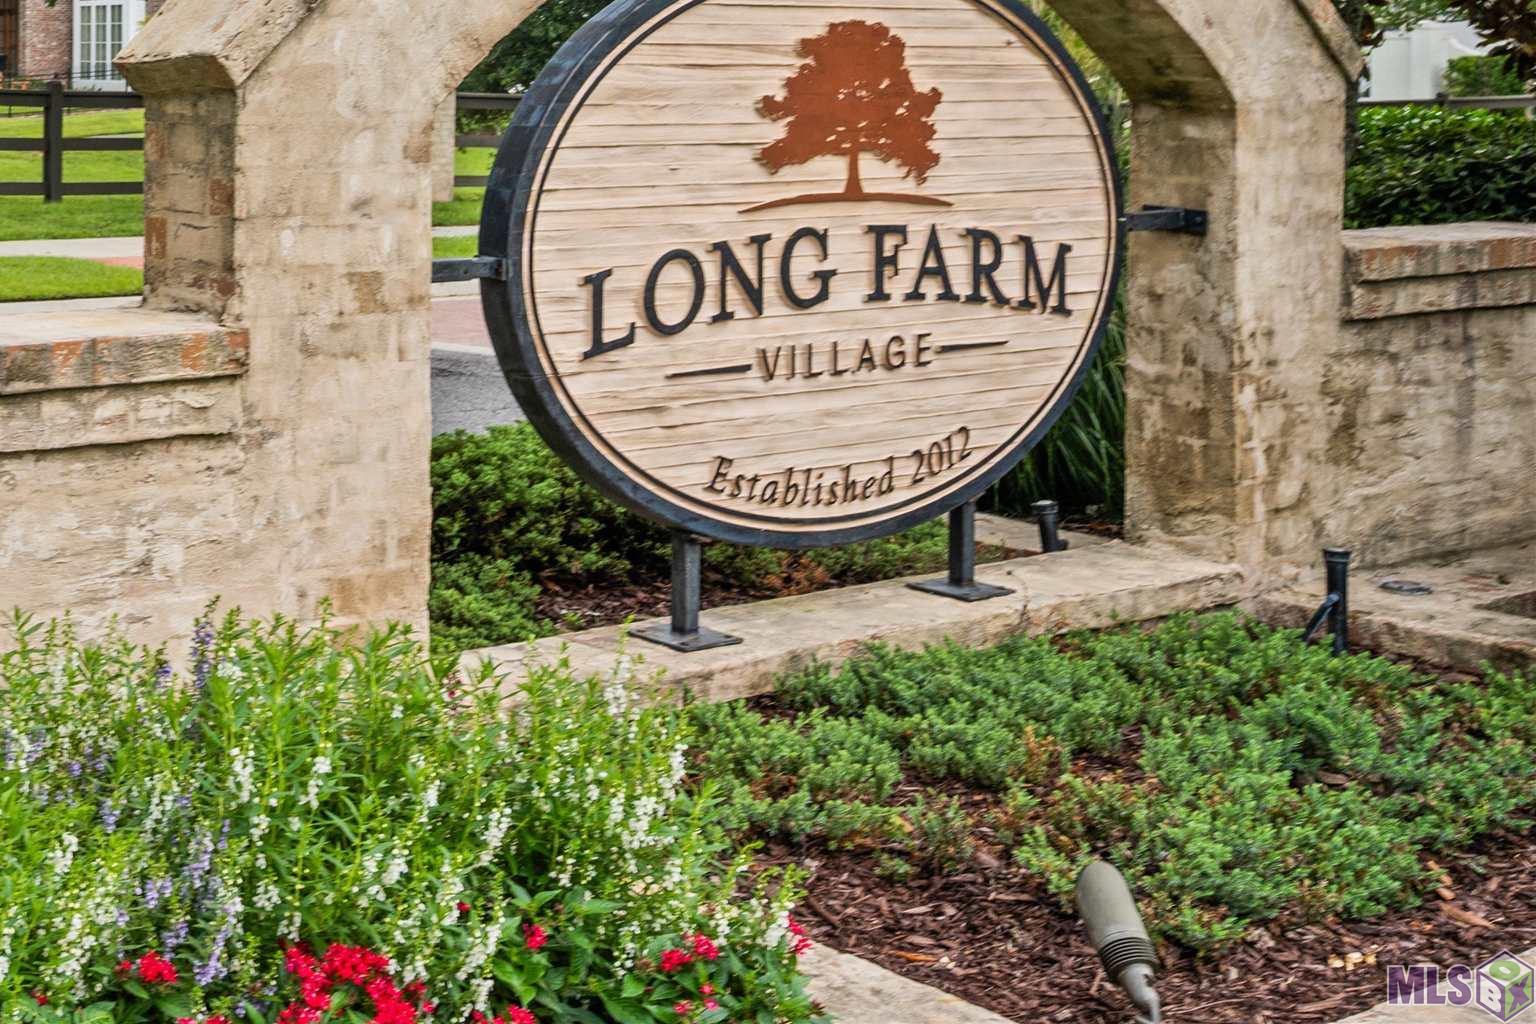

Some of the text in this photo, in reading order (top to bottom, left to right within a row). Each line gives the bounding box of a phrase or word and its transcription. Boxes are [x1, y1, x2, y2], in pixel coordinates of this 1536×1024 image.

[580, 223, 1073, 361] LONG FARM
[758, 332, 934, 382] VILLAGE
[704, 426, 972, 508] Established 2012
